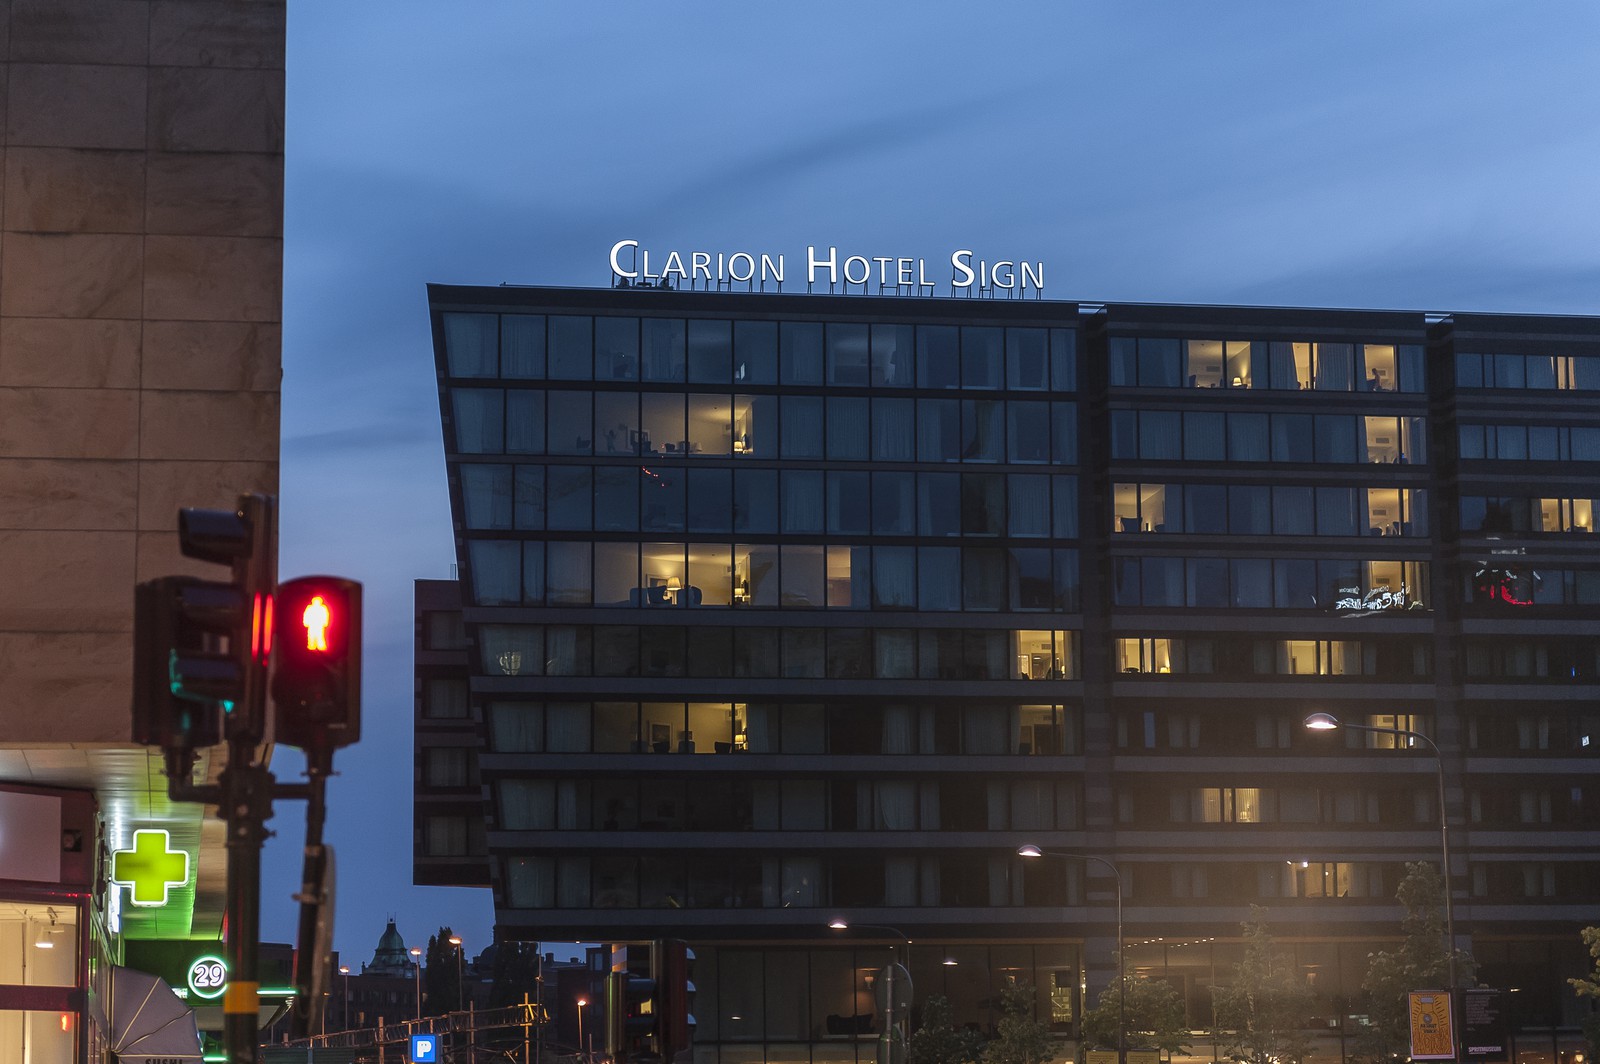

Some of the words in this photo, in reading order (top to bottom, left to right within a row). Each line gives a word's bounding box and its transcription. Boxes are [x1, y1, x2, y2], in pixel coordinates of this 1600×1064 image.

[609, 239, 785, 282] CLARION
[807, 246, 936, 287] HOTEL
[951, 249, 1044, 290] SIGN
[193, 963, 225, 987] 29
[416, 1040, 432, 1058] P
